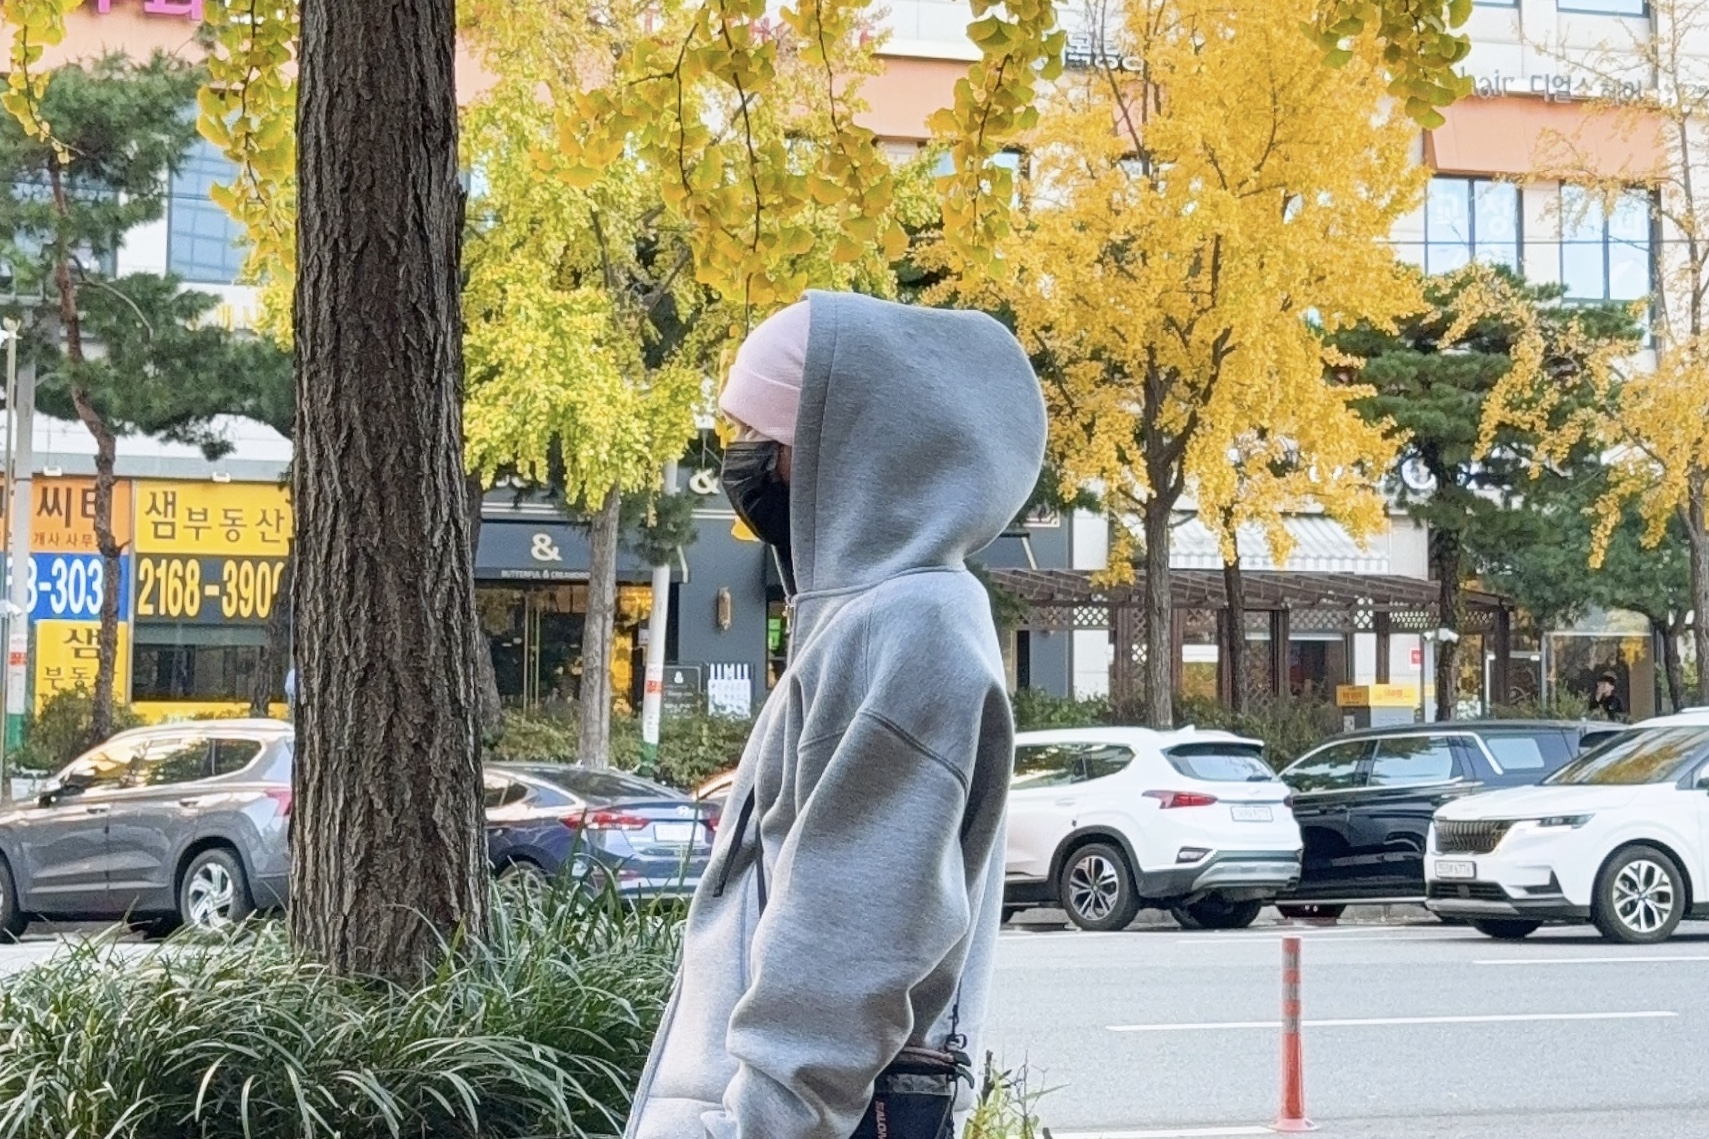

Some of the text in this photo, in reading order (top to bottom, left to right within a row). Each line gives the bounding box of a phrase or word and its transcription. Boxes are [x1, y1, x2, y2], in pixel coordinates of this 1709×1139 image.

[145, 490, 285, 544] 샘부동산
[66, 533, 93, 547] 사무
[531, 533, 562, 561] &
[43, 666, 94, 692] 부동
